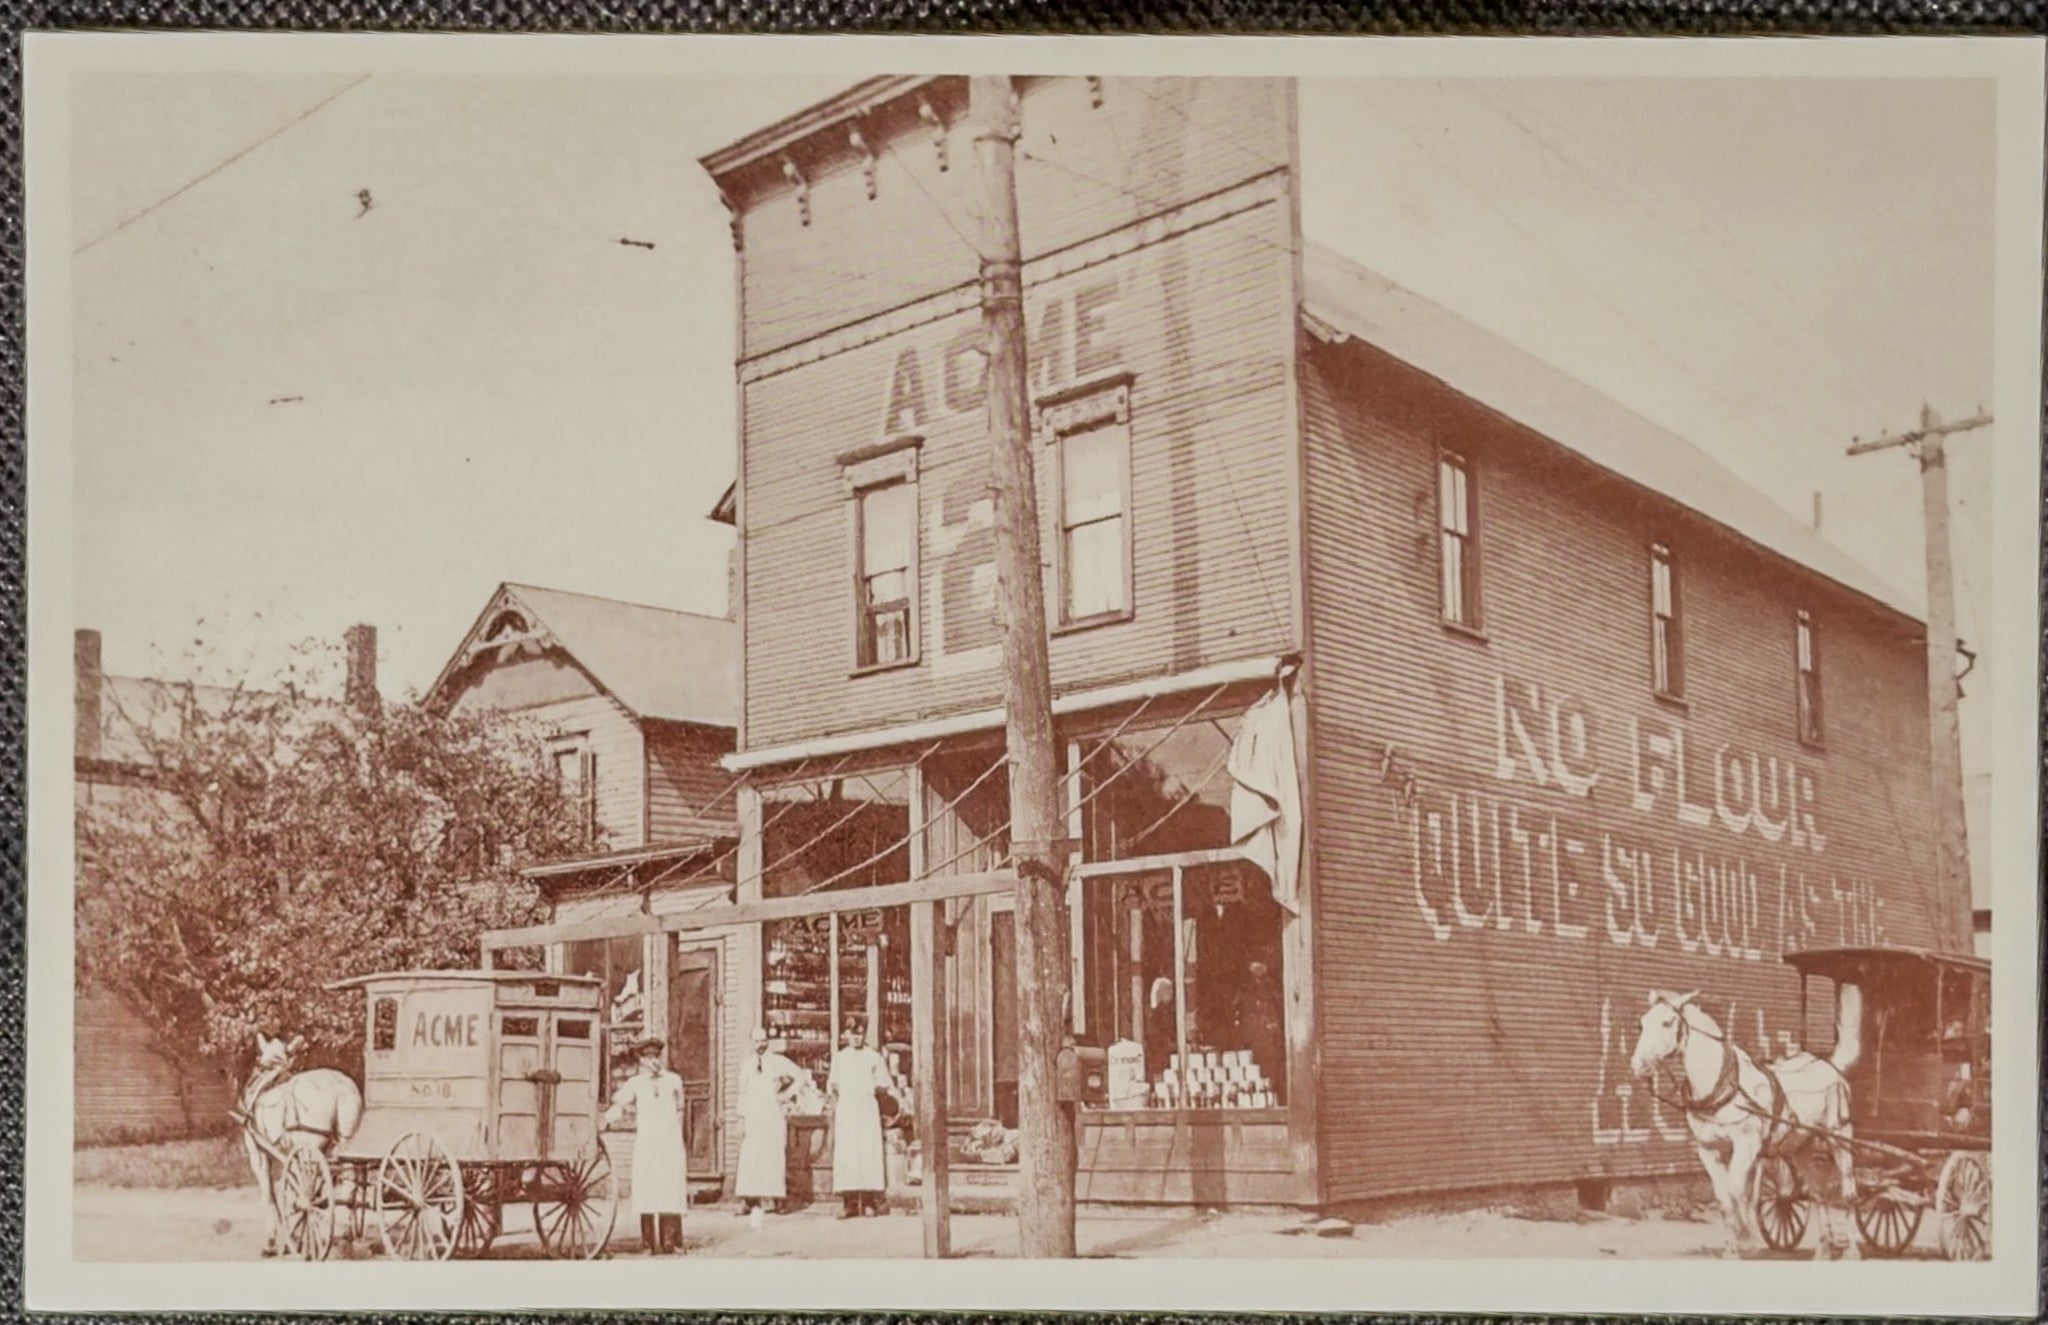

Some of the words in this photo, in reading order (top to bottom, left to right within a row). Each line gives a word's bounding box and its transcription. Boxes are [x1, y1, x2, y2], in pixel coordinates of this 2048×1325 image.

[1496, 672, 1601, 798] NO
[1631, 712, 1827, 852] FLOUR
[1411, 794, 1591, 941] QUITE
[1602, 832, 1661, 948] SO
[1673, 845, 1763, 961] GOOD
[411, 1012, 480, 1047] ACME
